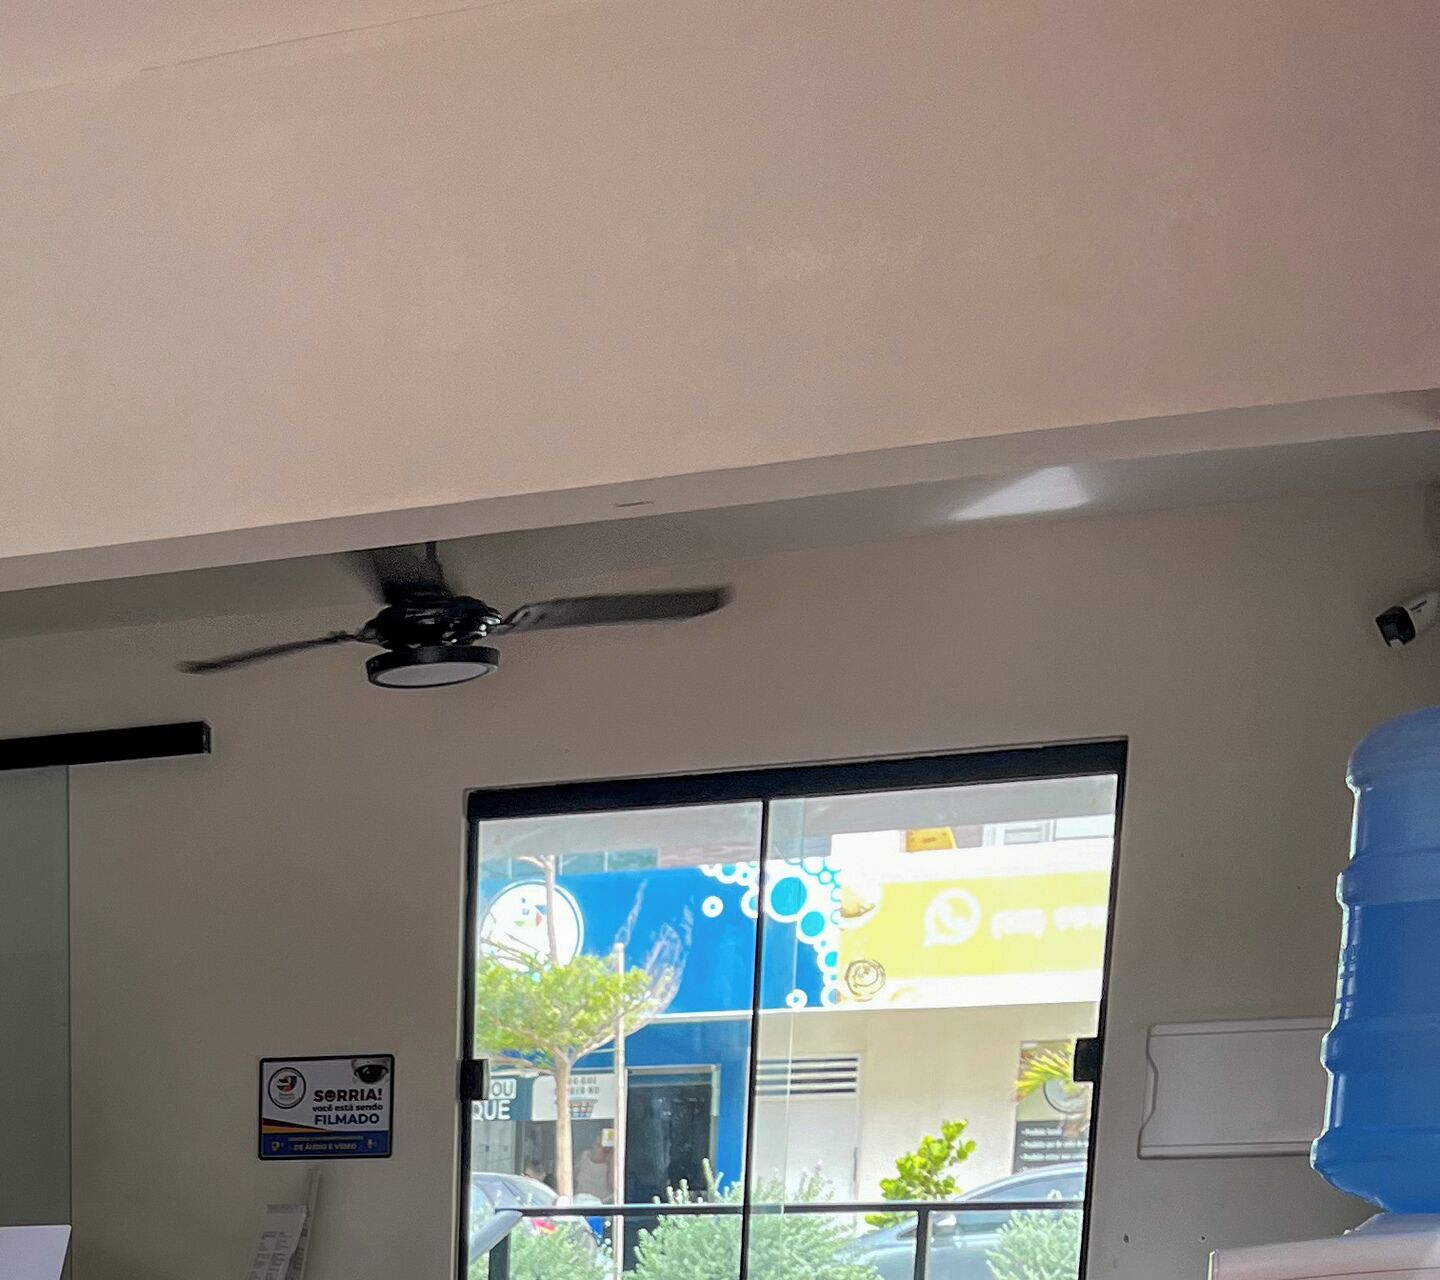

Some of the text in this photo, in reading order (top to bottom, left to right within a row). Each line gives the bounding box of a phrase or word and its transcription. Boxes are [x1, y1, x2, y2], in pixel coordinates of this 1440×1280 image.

[313, 1088, 382, 1102] SORRIA!
[312, 1103, 333, 1112] você
[355, 1102, 383, 1112] sendo
[314, 1113, 380, 1125] FILMADO
